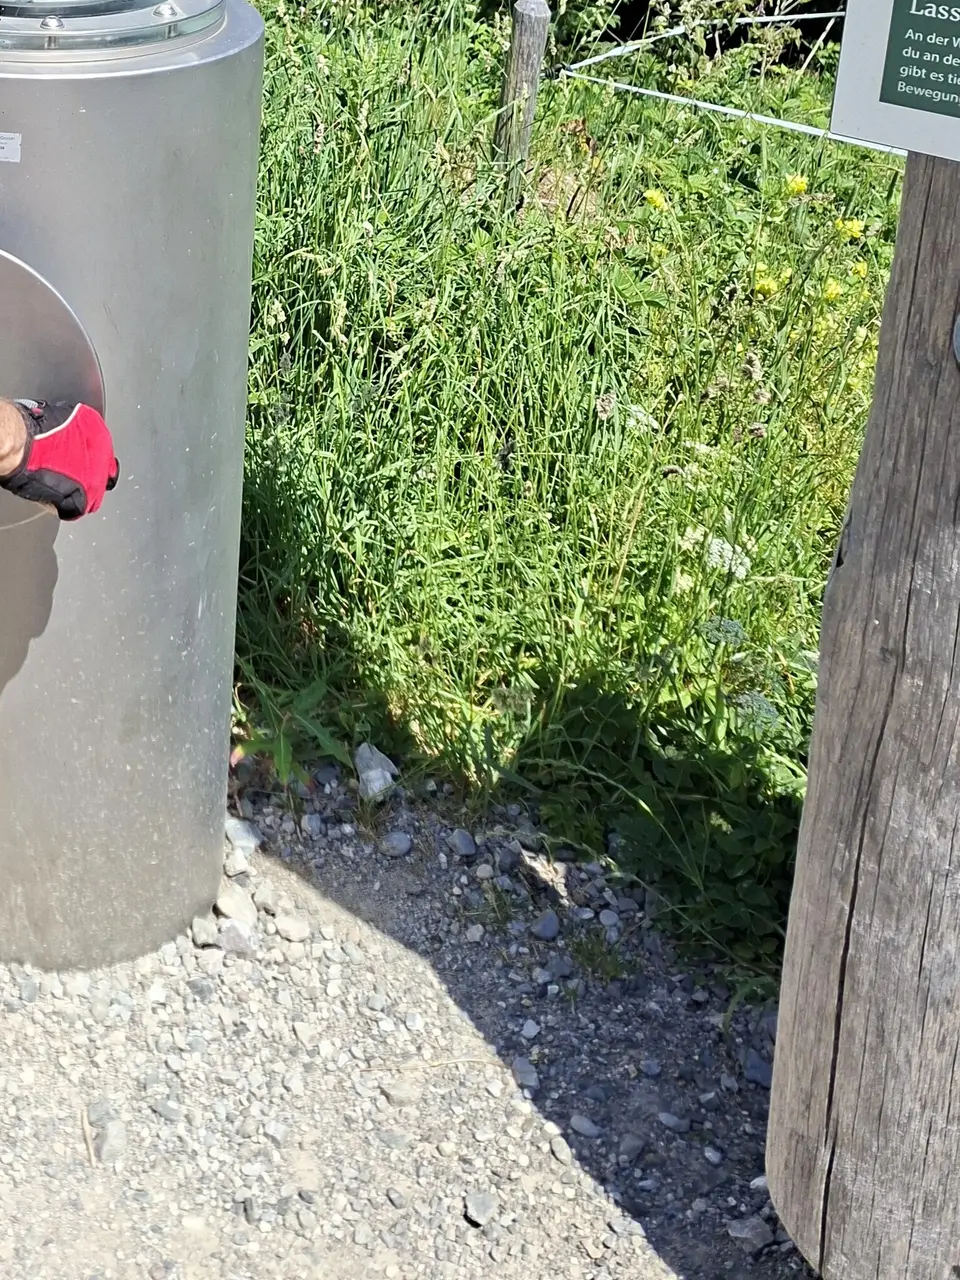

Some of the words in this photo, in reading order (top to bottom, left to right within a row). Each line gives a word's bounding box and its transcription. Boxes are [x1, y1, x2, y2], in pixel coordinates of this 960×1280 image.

[904, 28, 923, 42] An
[926, 32, 950, 46] der
[902, 46, 920, 59] du
[923, 52, 940, 63] an
[899, 65, 927, 79] gibt
[929, 71, 944, 82] es
[897, 80, 960, 106] Bewegun
